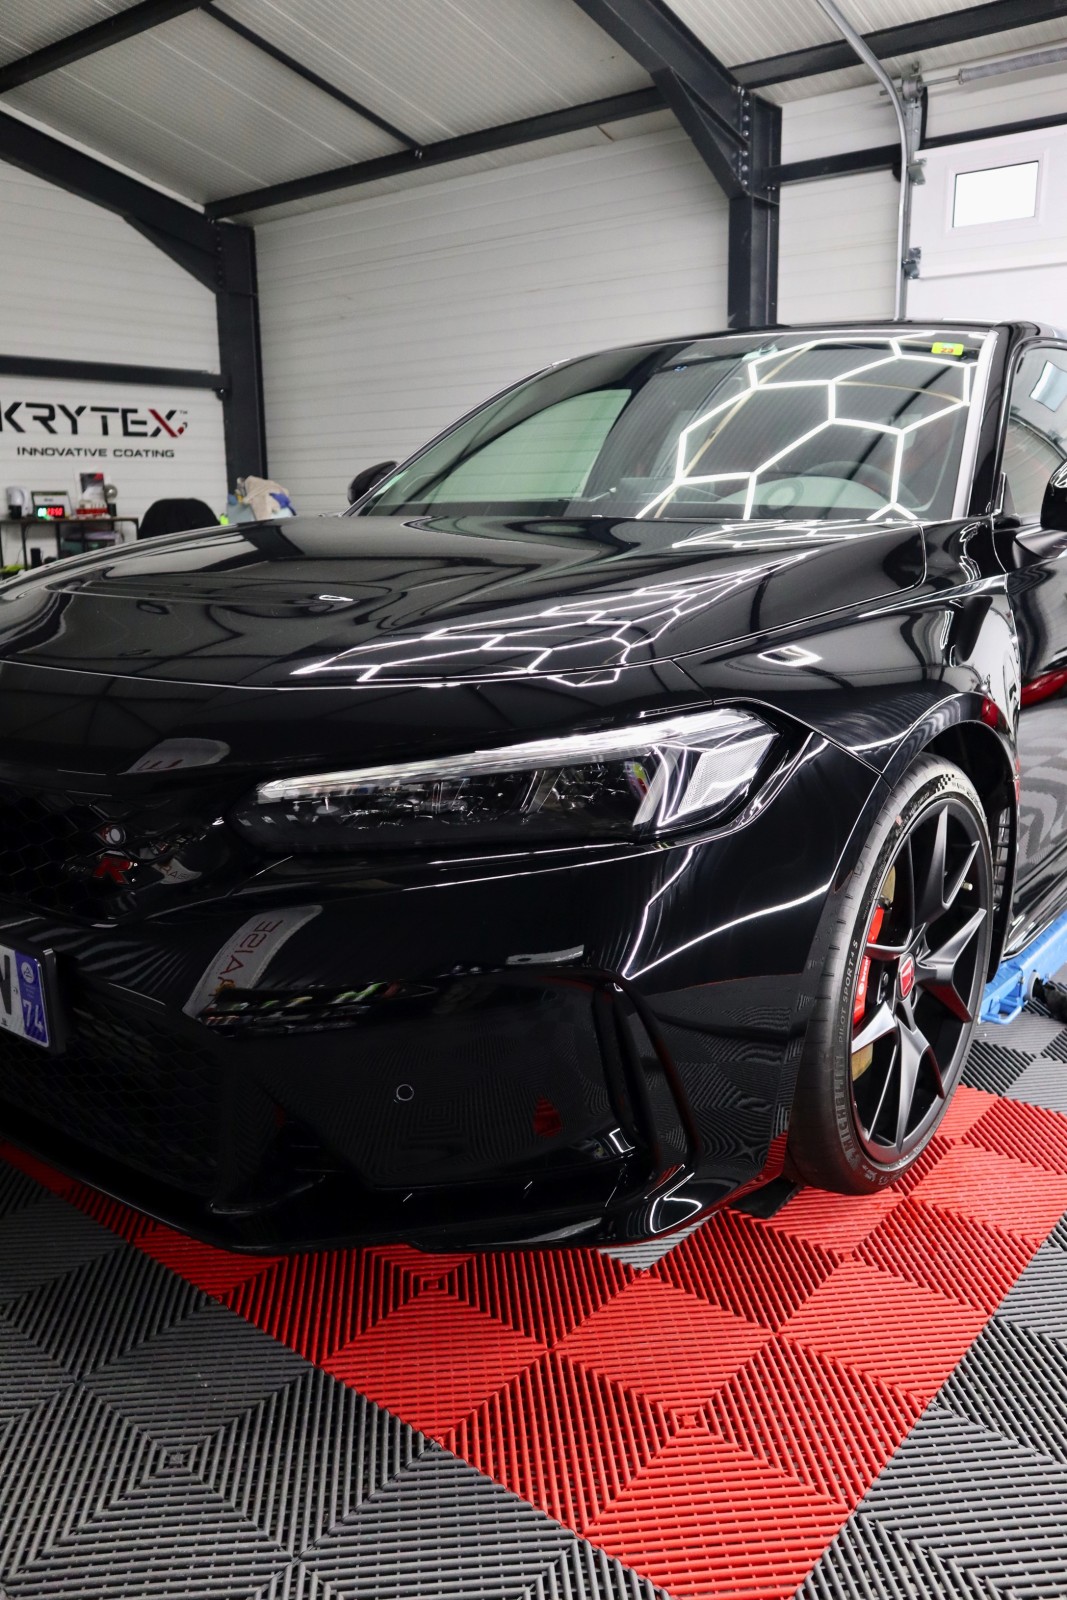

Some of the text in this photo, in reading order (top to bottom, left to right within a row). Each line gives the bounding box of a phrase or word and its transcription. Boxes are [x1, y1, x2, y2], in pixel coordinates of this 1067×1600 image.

[0, 401, 178, 438] KRYTEX
[16, 446, 175, 459] INNOVATIVE COATING
[842, 959, 854, 1004] SPORT
[22, 998, 44, 1033] 74
[838, 1007, 847, 1043] PILOT
